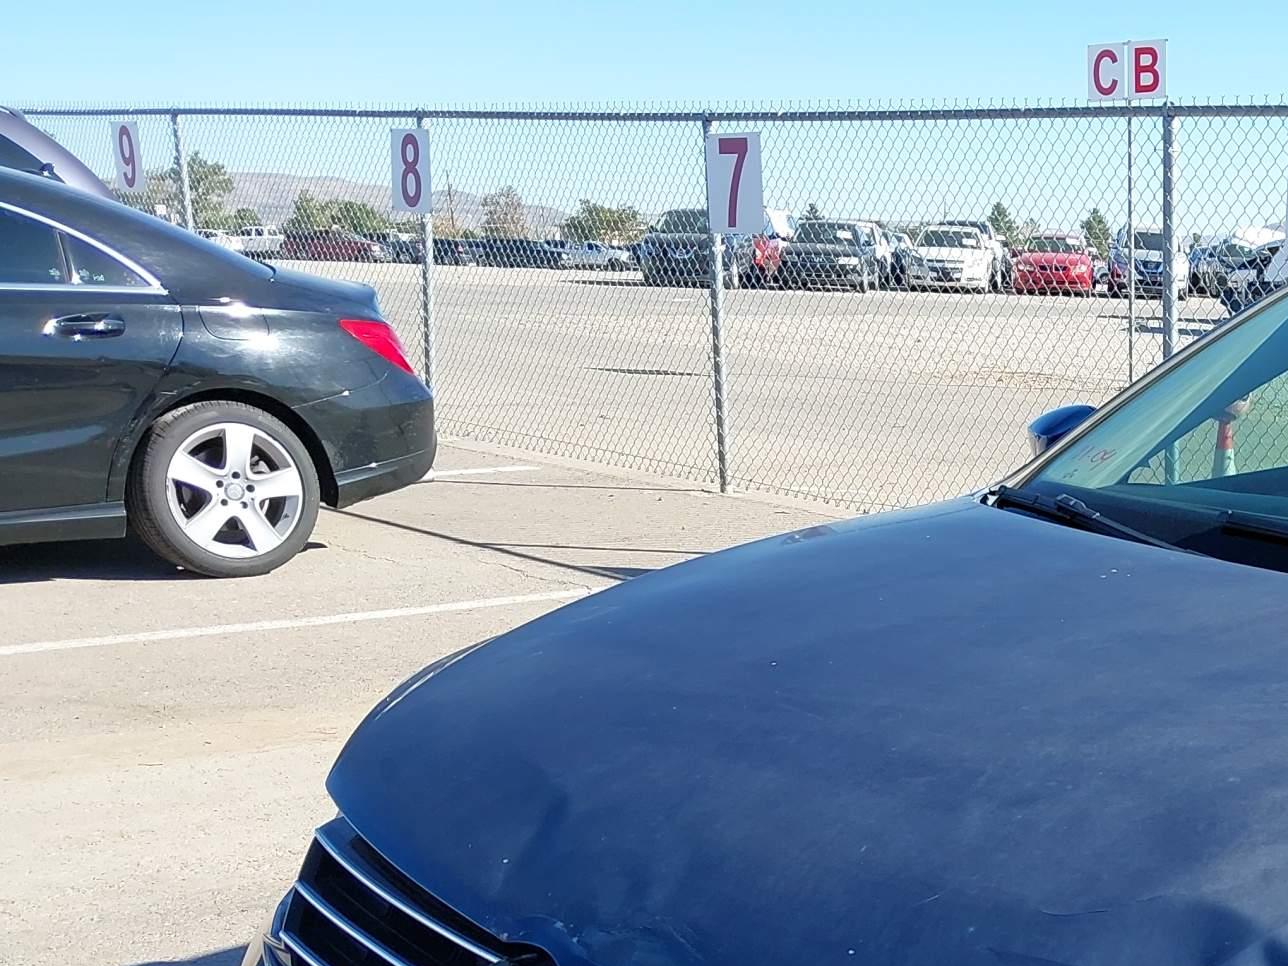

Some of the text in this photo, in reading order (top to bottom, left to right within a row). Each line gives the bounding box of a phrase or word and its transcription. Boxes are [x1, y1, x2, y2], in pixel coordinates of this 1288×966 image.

[1092, 48, 1119, 97] C
[1132, 45, 1162, 95] B
[118, 124, 136, 188] 9
[400, 132, 422, 208] 8
[717, 137, 748, 228] 7
